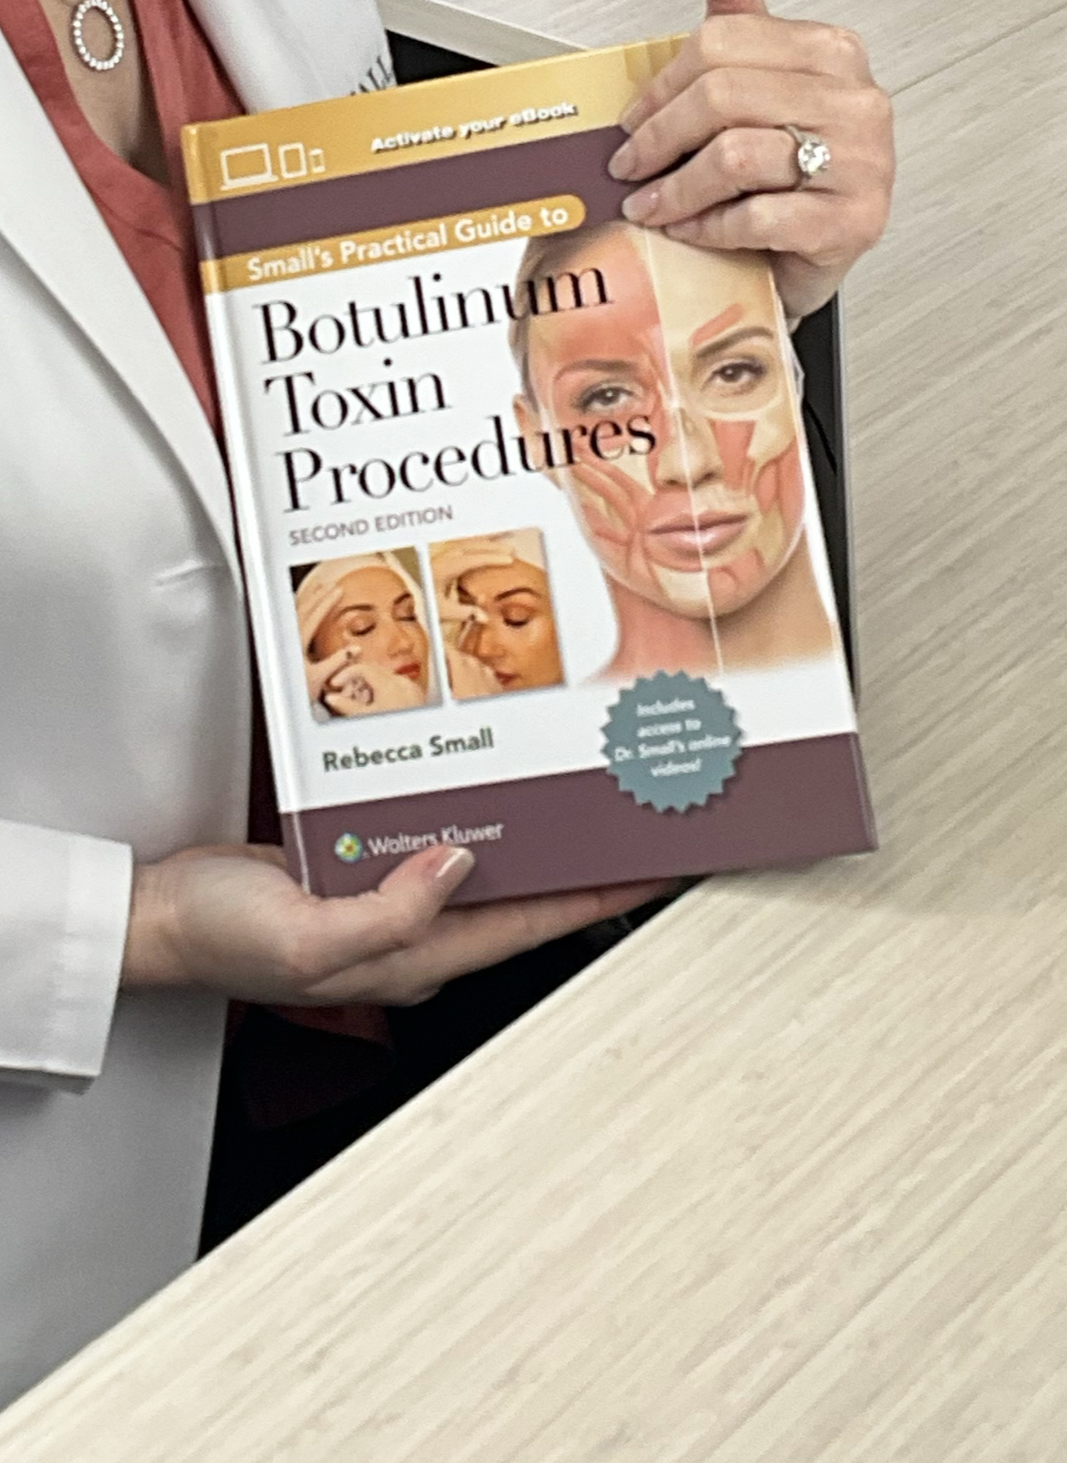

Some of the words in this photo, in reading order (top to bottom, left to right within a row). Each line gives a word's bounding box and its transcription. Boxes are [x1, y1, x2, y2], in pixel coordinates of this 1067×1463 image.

[371, 125, 454, 153] Activate
[459, 116, 505, 139] your
[510, 102, 578, 126] eBook
[246, 246, 334, 281] Small's
[340, 224, 448, 264] Practical
[454, 210, 532, 242] Guide
[539, 206, 568, 228] to
[254, 264, 614, 364] Botulinum
[265, 358, 452, 437] Toxin
[275, 411, 657, 514] Procedures
[288, 519, 370, 546] SECOND
[374, 505, 454, 532] EDITION
[322, 746, 423, 773] Rebecca
[429, 726, 494, 757] Small
[684, 719, 702, 731] to
[368, 832, 438, 856] Wolters
[441, 823, 504, 844] Kluwer
